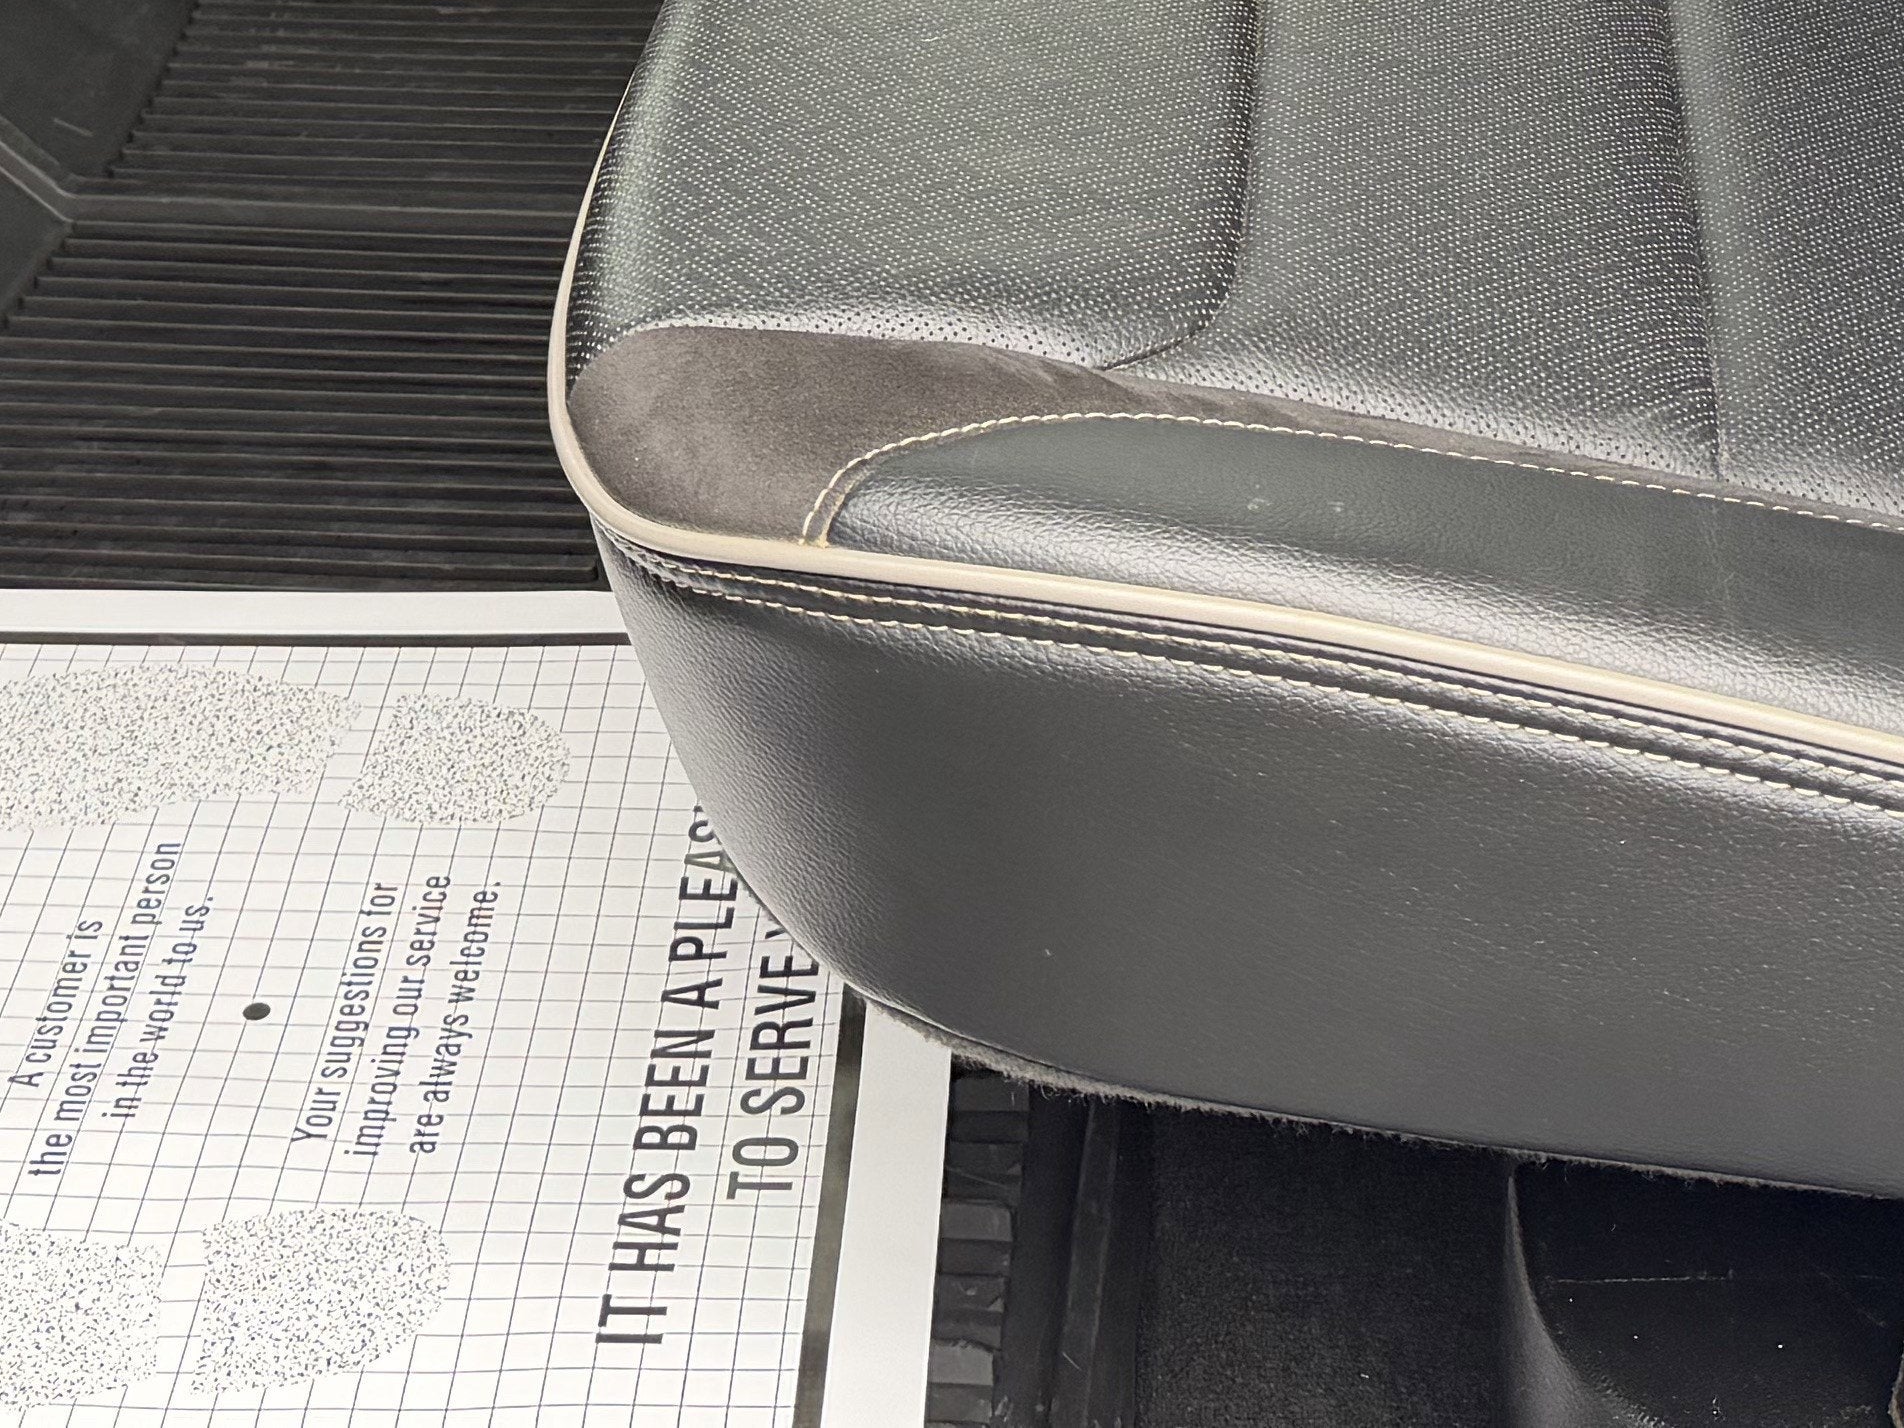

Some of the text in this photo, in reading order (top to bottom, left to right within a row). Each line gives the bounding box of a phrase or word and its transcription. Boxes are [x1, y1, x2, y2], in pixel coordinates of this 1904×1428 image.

[7, 919, 103, 1087] A customer is
[28, 841, 182, 1177] the most important person
[102, 895, 214, 1118] in the world to us.
[290, 881, 398, 1144] Your suggestions for
[343, 875, 451, 1157] improving our service
[408, 880, 502, 1155] are always welcome.
[595, 804, 739, 1345] IT HAS BEEN A PLEA
[725, 954, 820, 1200] TO SERVE
